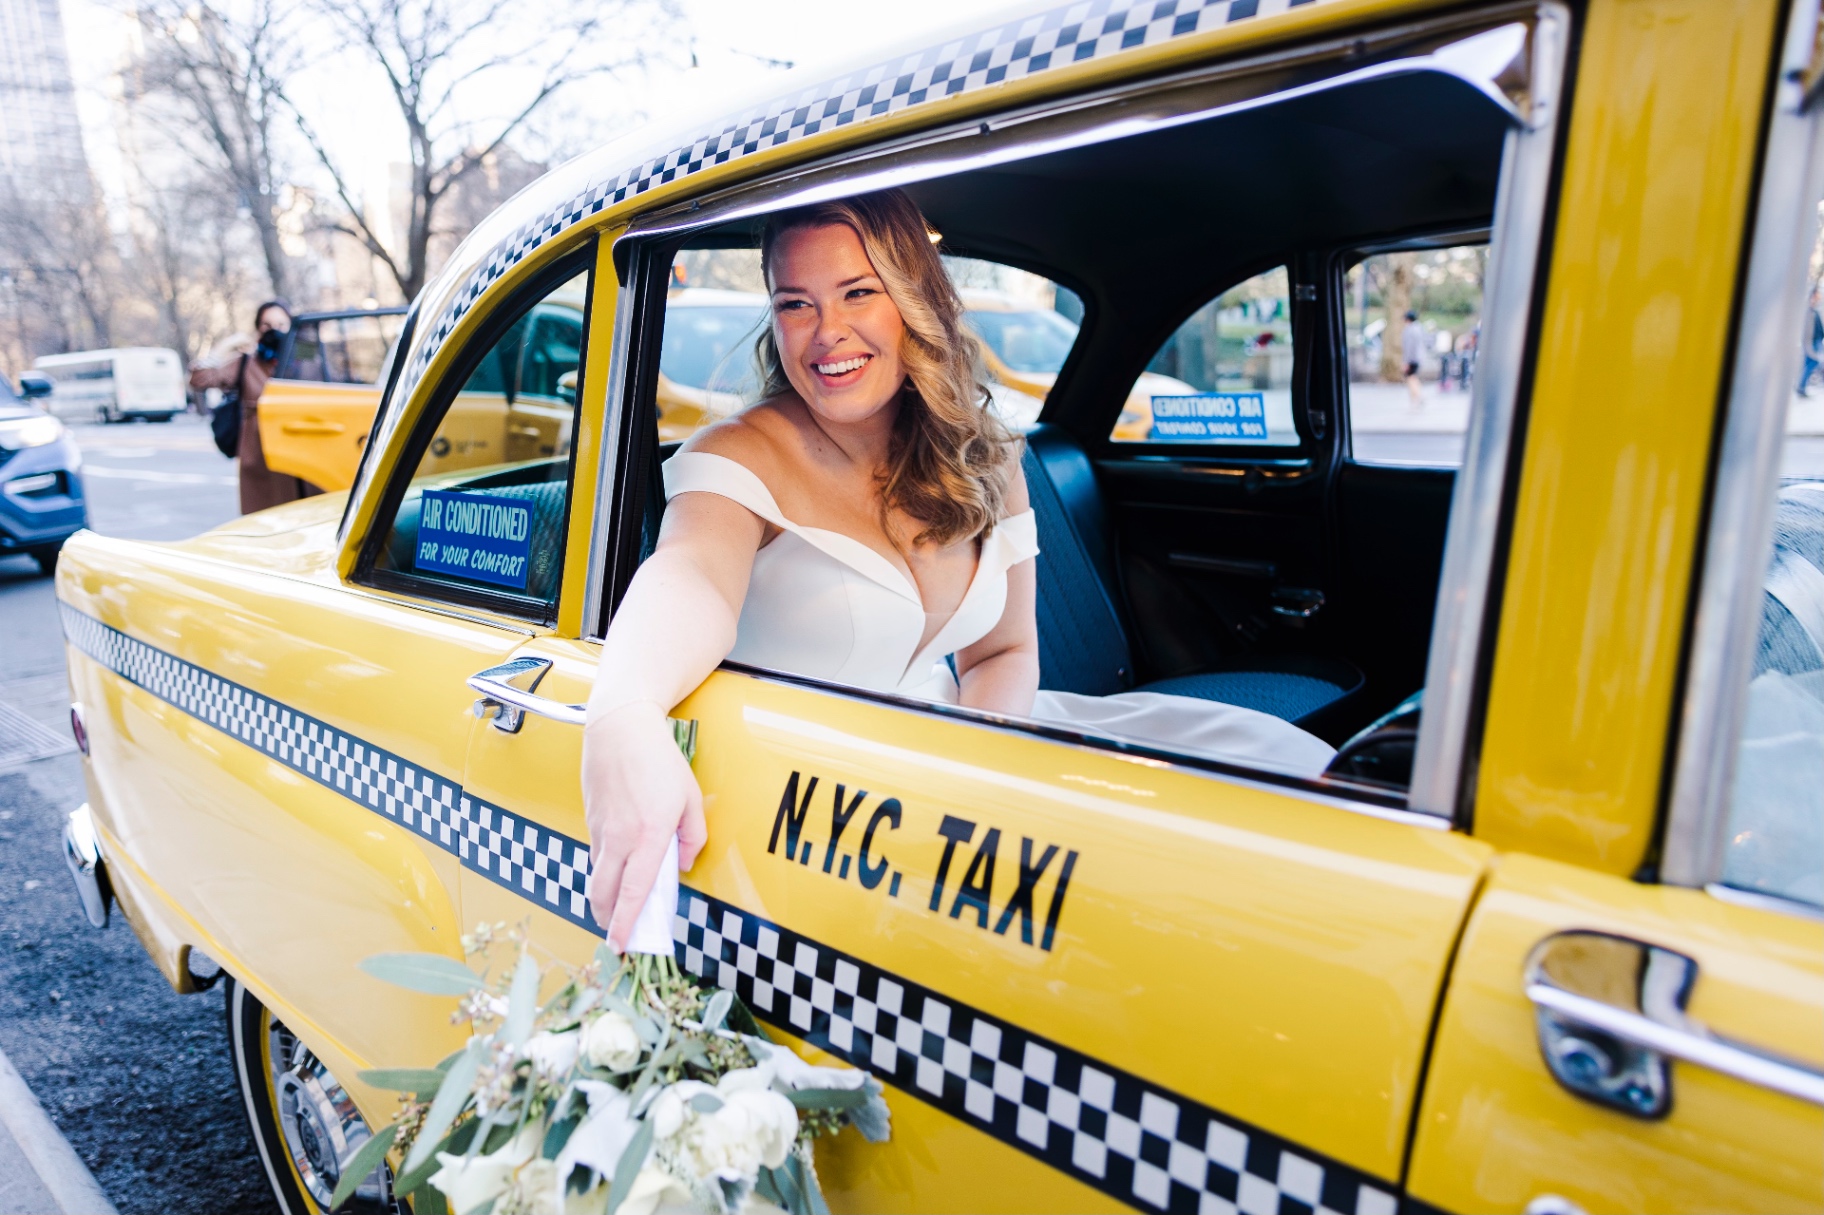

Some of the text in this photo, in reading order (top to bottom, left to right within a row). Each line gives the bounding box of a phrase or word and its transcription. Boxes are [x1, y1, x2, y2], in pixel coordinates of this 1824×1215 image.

[422, 498, 528, 542] AIR CONDITIONED
[420, 542, 439, 561] FOR
[441, 545, 469, 567] YOUR
[471, 549, 525, 577] COMFORT
[767, 770, 1079, 953] N.Y.C. TAXI
